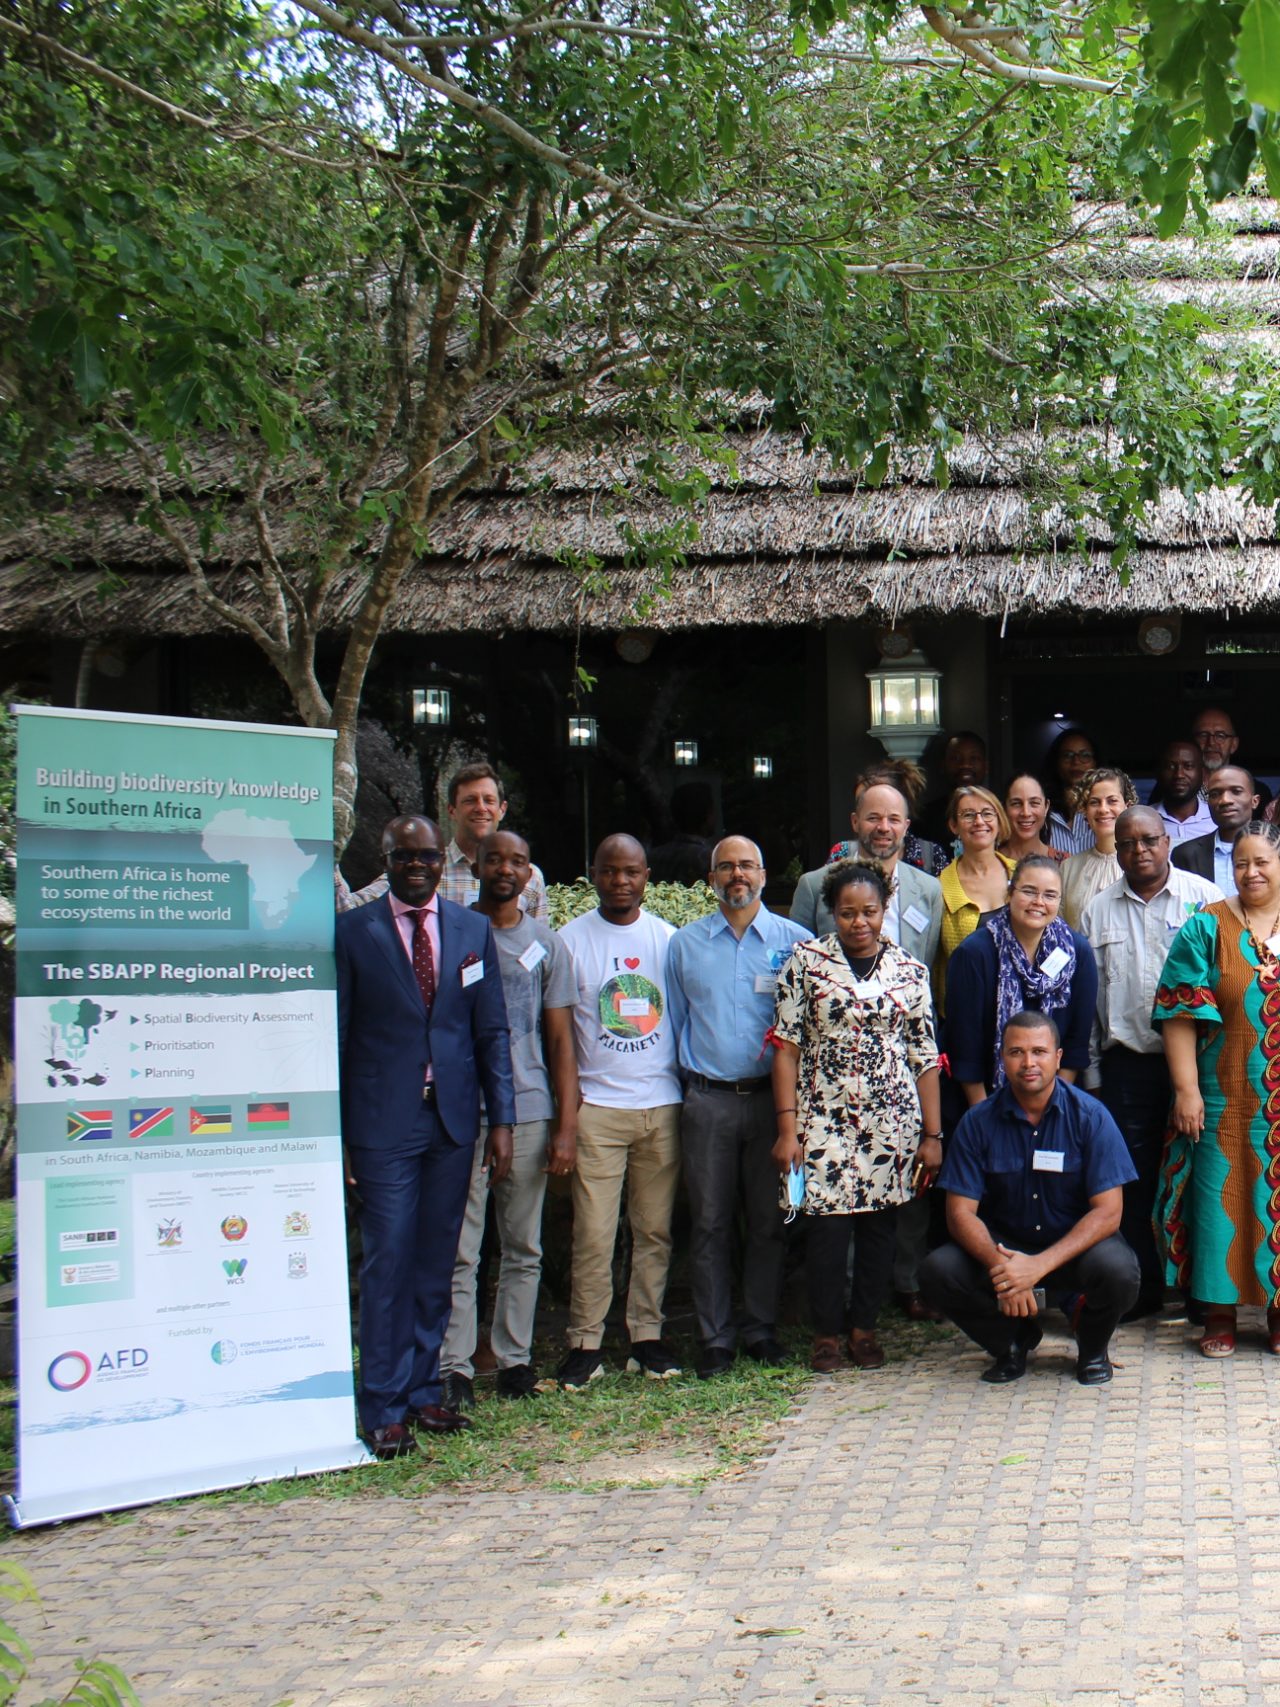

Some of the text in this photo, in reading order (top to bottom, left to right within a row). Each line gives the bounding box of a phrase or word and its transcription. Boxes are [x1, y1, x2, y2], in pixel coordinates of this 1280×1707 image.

[36, 768, 320, 804] Building biodiversity knowledge
[44, 797, 202, 820] in Southern Africa
[41, 865, 231, 883] Southern Africa is home
[41, 886, 214, 902] to some of the richest
[41, 907, 231, 923] ecosystems in the world
[613, 957, 619, 971] I
[43, 963, 314, 983] The SBAPP Regional Project
[144, 1012, 314, 1026] Spatial Biodiversity Assessment
[145, 1040, 215, 1052] Prioritisation
[145, 1067, 195, 1080] Planning
[45, 1141, 318, 1166] in South Africa, Namibia, Mozambique and Malawi
[168, 1327, 200, 1337] Funded
[97, 1348, 149, 1371] AFD
